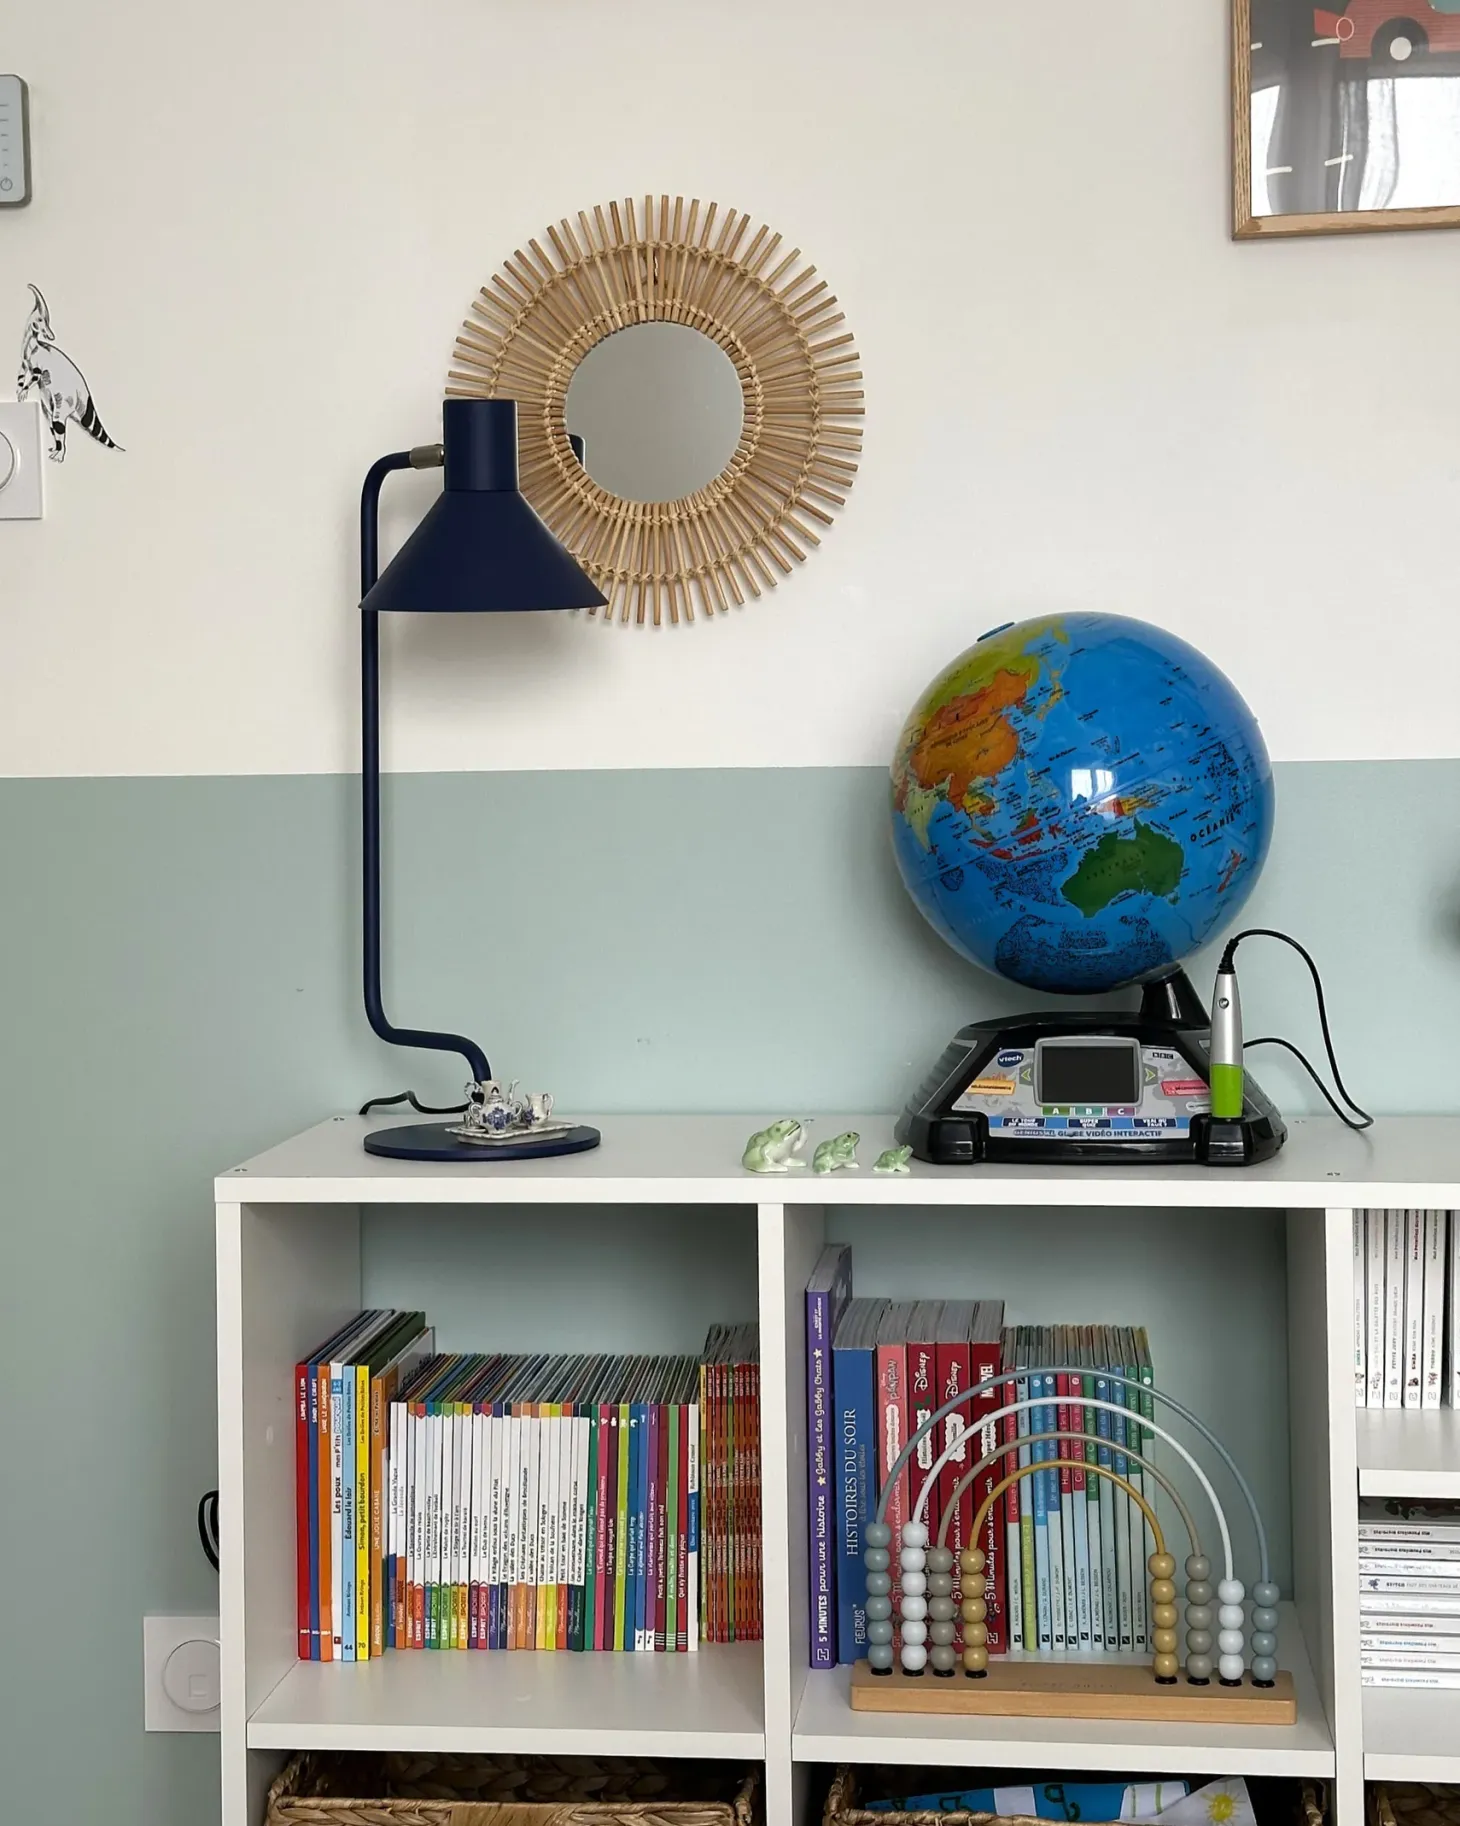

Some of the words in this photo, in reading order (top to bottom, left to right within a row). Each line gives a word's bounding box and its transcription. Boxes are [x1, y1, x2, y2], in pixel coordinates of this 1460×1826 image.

[1191, 813, 1234, 842] OCÉANIE
[1086, 1128, 1112, 1137] VIDÉO
[1114, 1130, 1162, 1138] INTERACTIF
[814, 1360, 823, 1385] Chats
[333, 1396, 342, 1434] pourquoi
[814, 1387, 824, 1416] Gabby
[815, 1419, 823, 1432] les
[817, 1434, 823, 1443] et
[844, 1408, 856, 1445] SOIR
[815, 1446, 826, 1474] Gabby
[845, 1449, 857, 1472] DU
[816, 1495, 826, 1538] histoire
[844, 1477, 858, 1556] HISTOIRES
[986, 1528, 998, 1550] pour
[819, 1563, 829, 1591] pour
[985, 1552, 995, 1591] Minutes
[818, 1595, 827, 1633] MINUTES
[854, 1610, 866, 1644] FLEURUS
